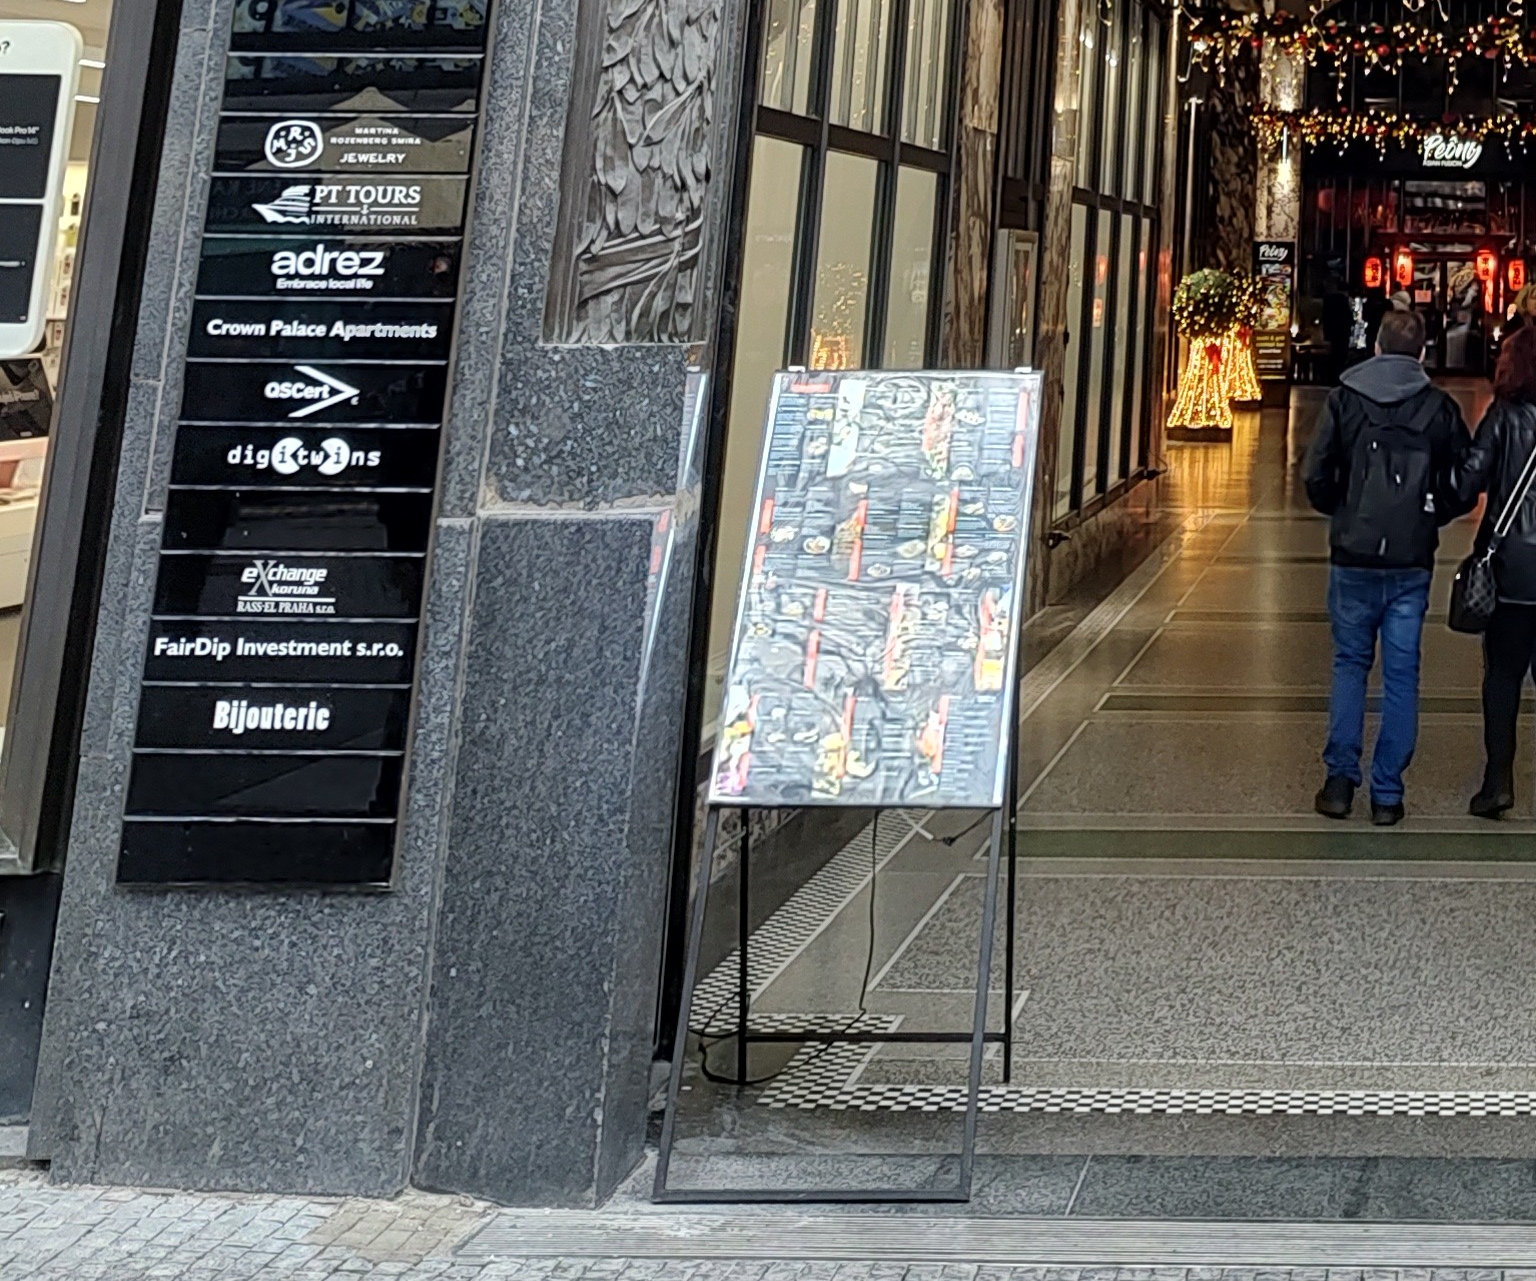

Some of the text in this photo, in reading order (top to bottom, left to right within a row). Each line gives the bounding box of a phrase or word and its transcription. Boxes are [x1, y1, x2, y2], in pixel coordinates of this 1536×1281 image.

[339, 152, 406, 164] JEWELRY
[312, 185, 422, 204] PT TOURS
[310, 213, 418, 226] INTERNATIONAL
[271, 243, 385, 276] adrez
[276, 278, 327, 289] Embrace
[328, 278, 355, 290] local
[206, 318, 438, 341] Crown Palace Apartments
[263, 381, 331, 399] QSCert
[227, 438, 382, 473] digitwins
[269, 584, 319, 595] koruna
[278, 602, 314, 613] PRAHA
[154, 637, 404, 661] FairDip Investment s.r.o.
